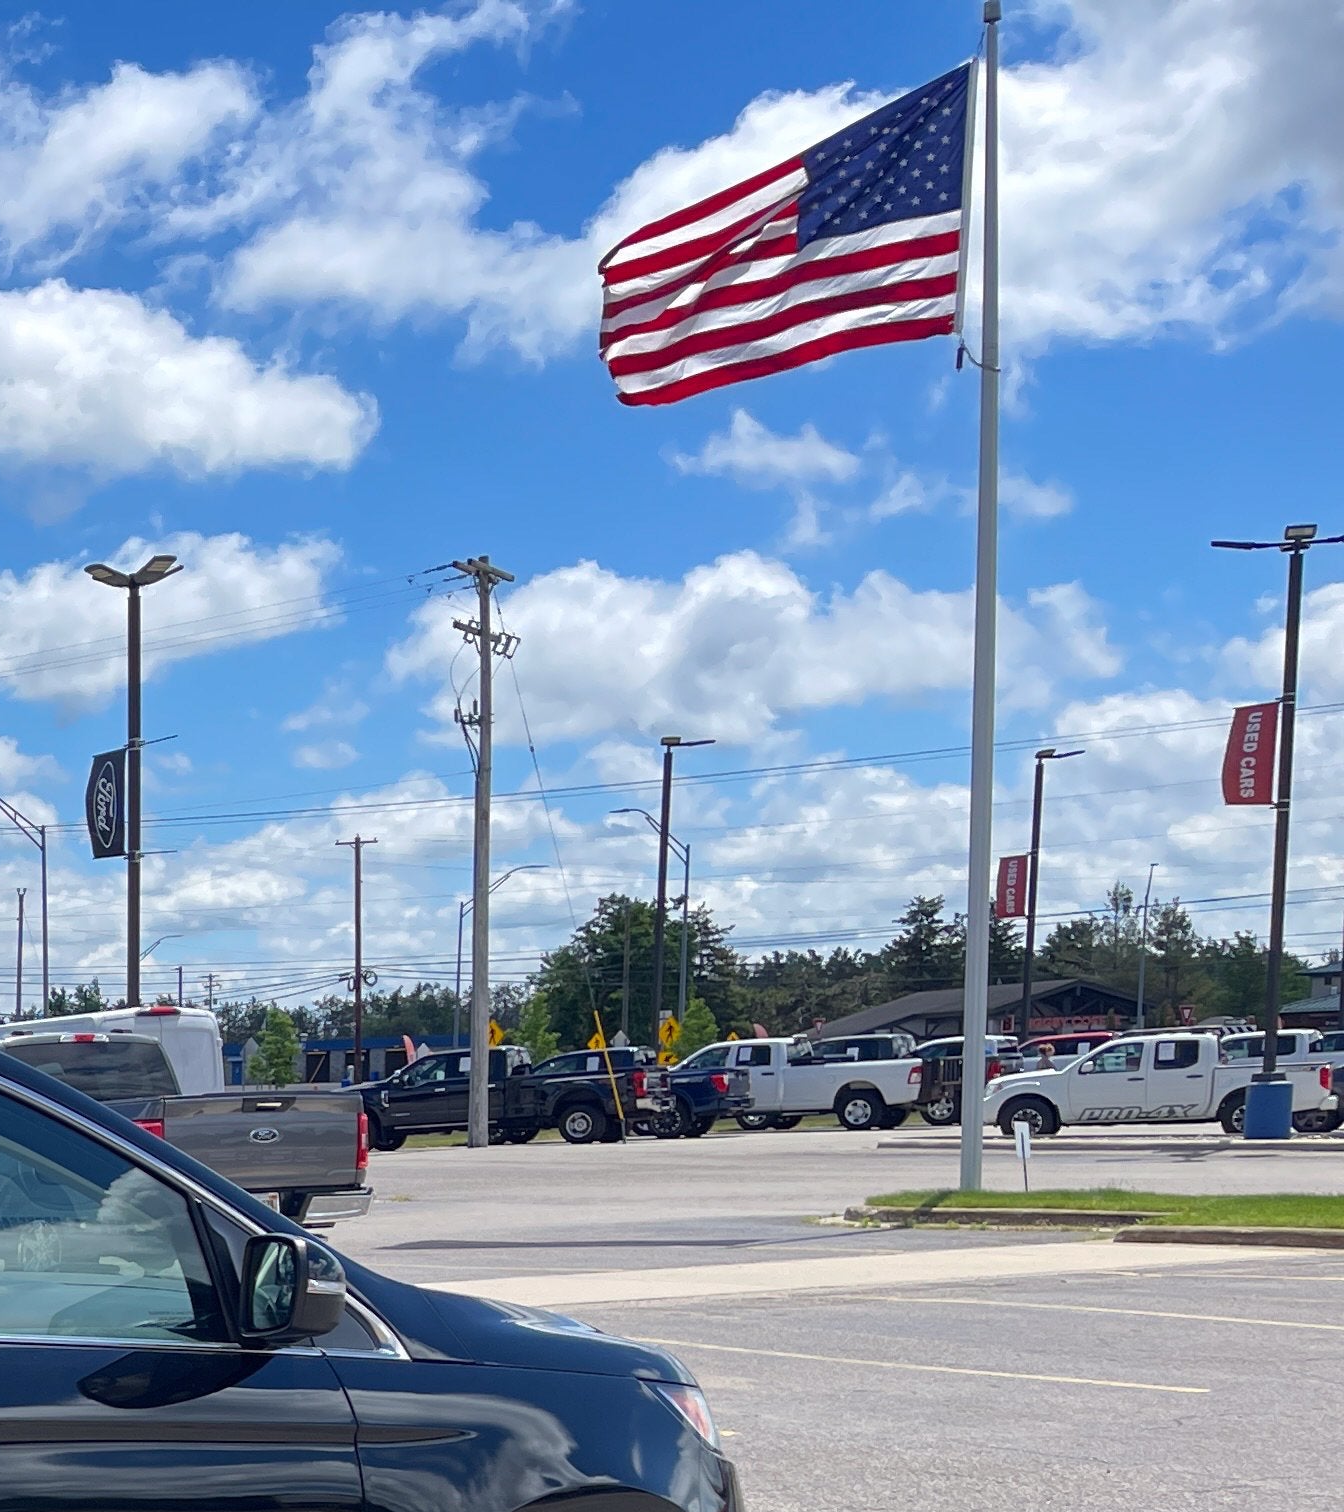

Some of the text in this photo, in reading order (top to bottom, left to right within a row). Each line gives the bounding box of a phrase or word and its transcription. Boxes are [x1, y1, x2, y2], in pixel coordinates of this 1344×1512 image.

[1239, 711, 1263, 799] USED CARS
[97, 777, 114, 832] Ford
[1006, 860, 1018, 914] USED CARS
[1079, 1103, 1200, 1121] PRO-4X
